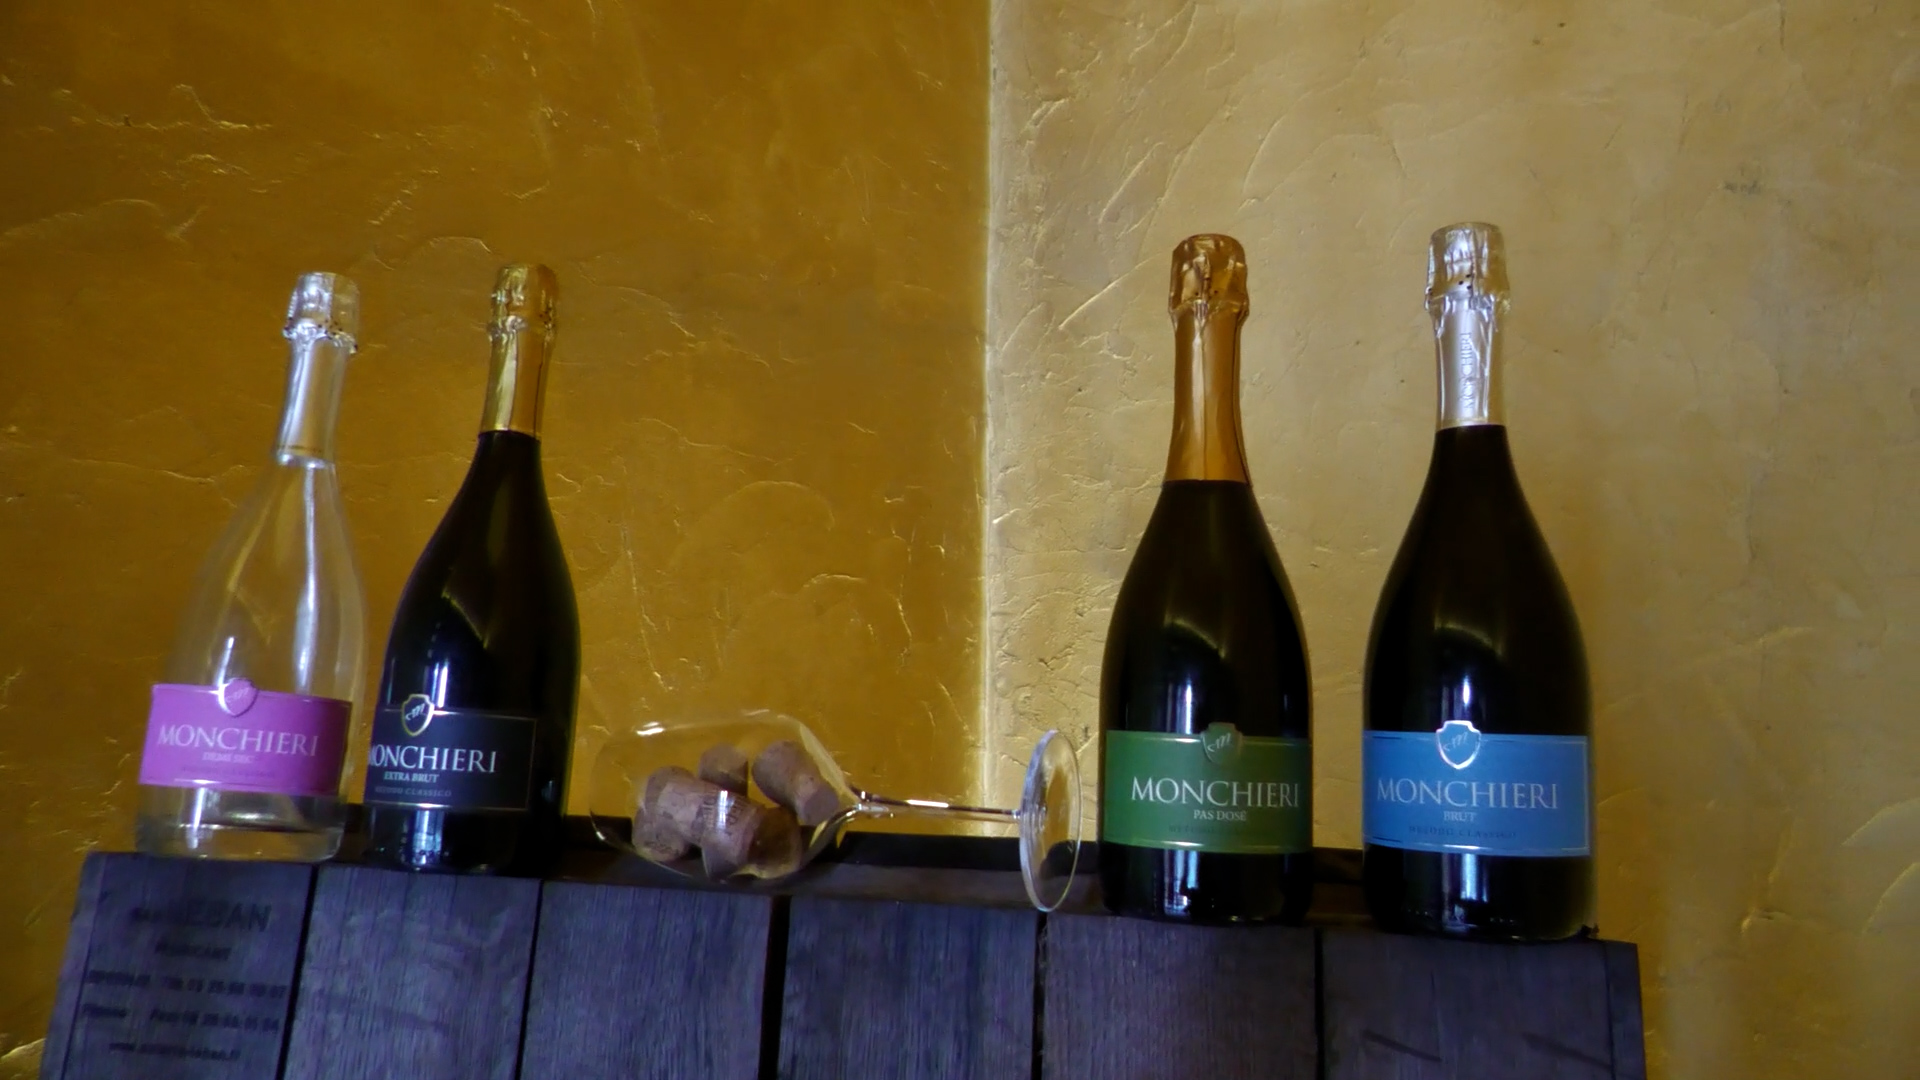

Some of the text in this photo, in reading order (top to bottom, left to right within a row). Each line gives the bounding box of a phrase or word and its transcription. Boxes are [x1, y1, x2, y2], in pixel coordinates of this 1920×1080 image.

[157, 724, 319, 758] MONCHIERI
[383, 771, 440, 784] EXTRA BRUT
[1131, 776, 1299, 808] MONCHIERI
[1376, 777, 1558, 810] MONCHIERI
[1193, 809, 1215, 821] PAS
[1443, 810, 1479, 823] BRUT
